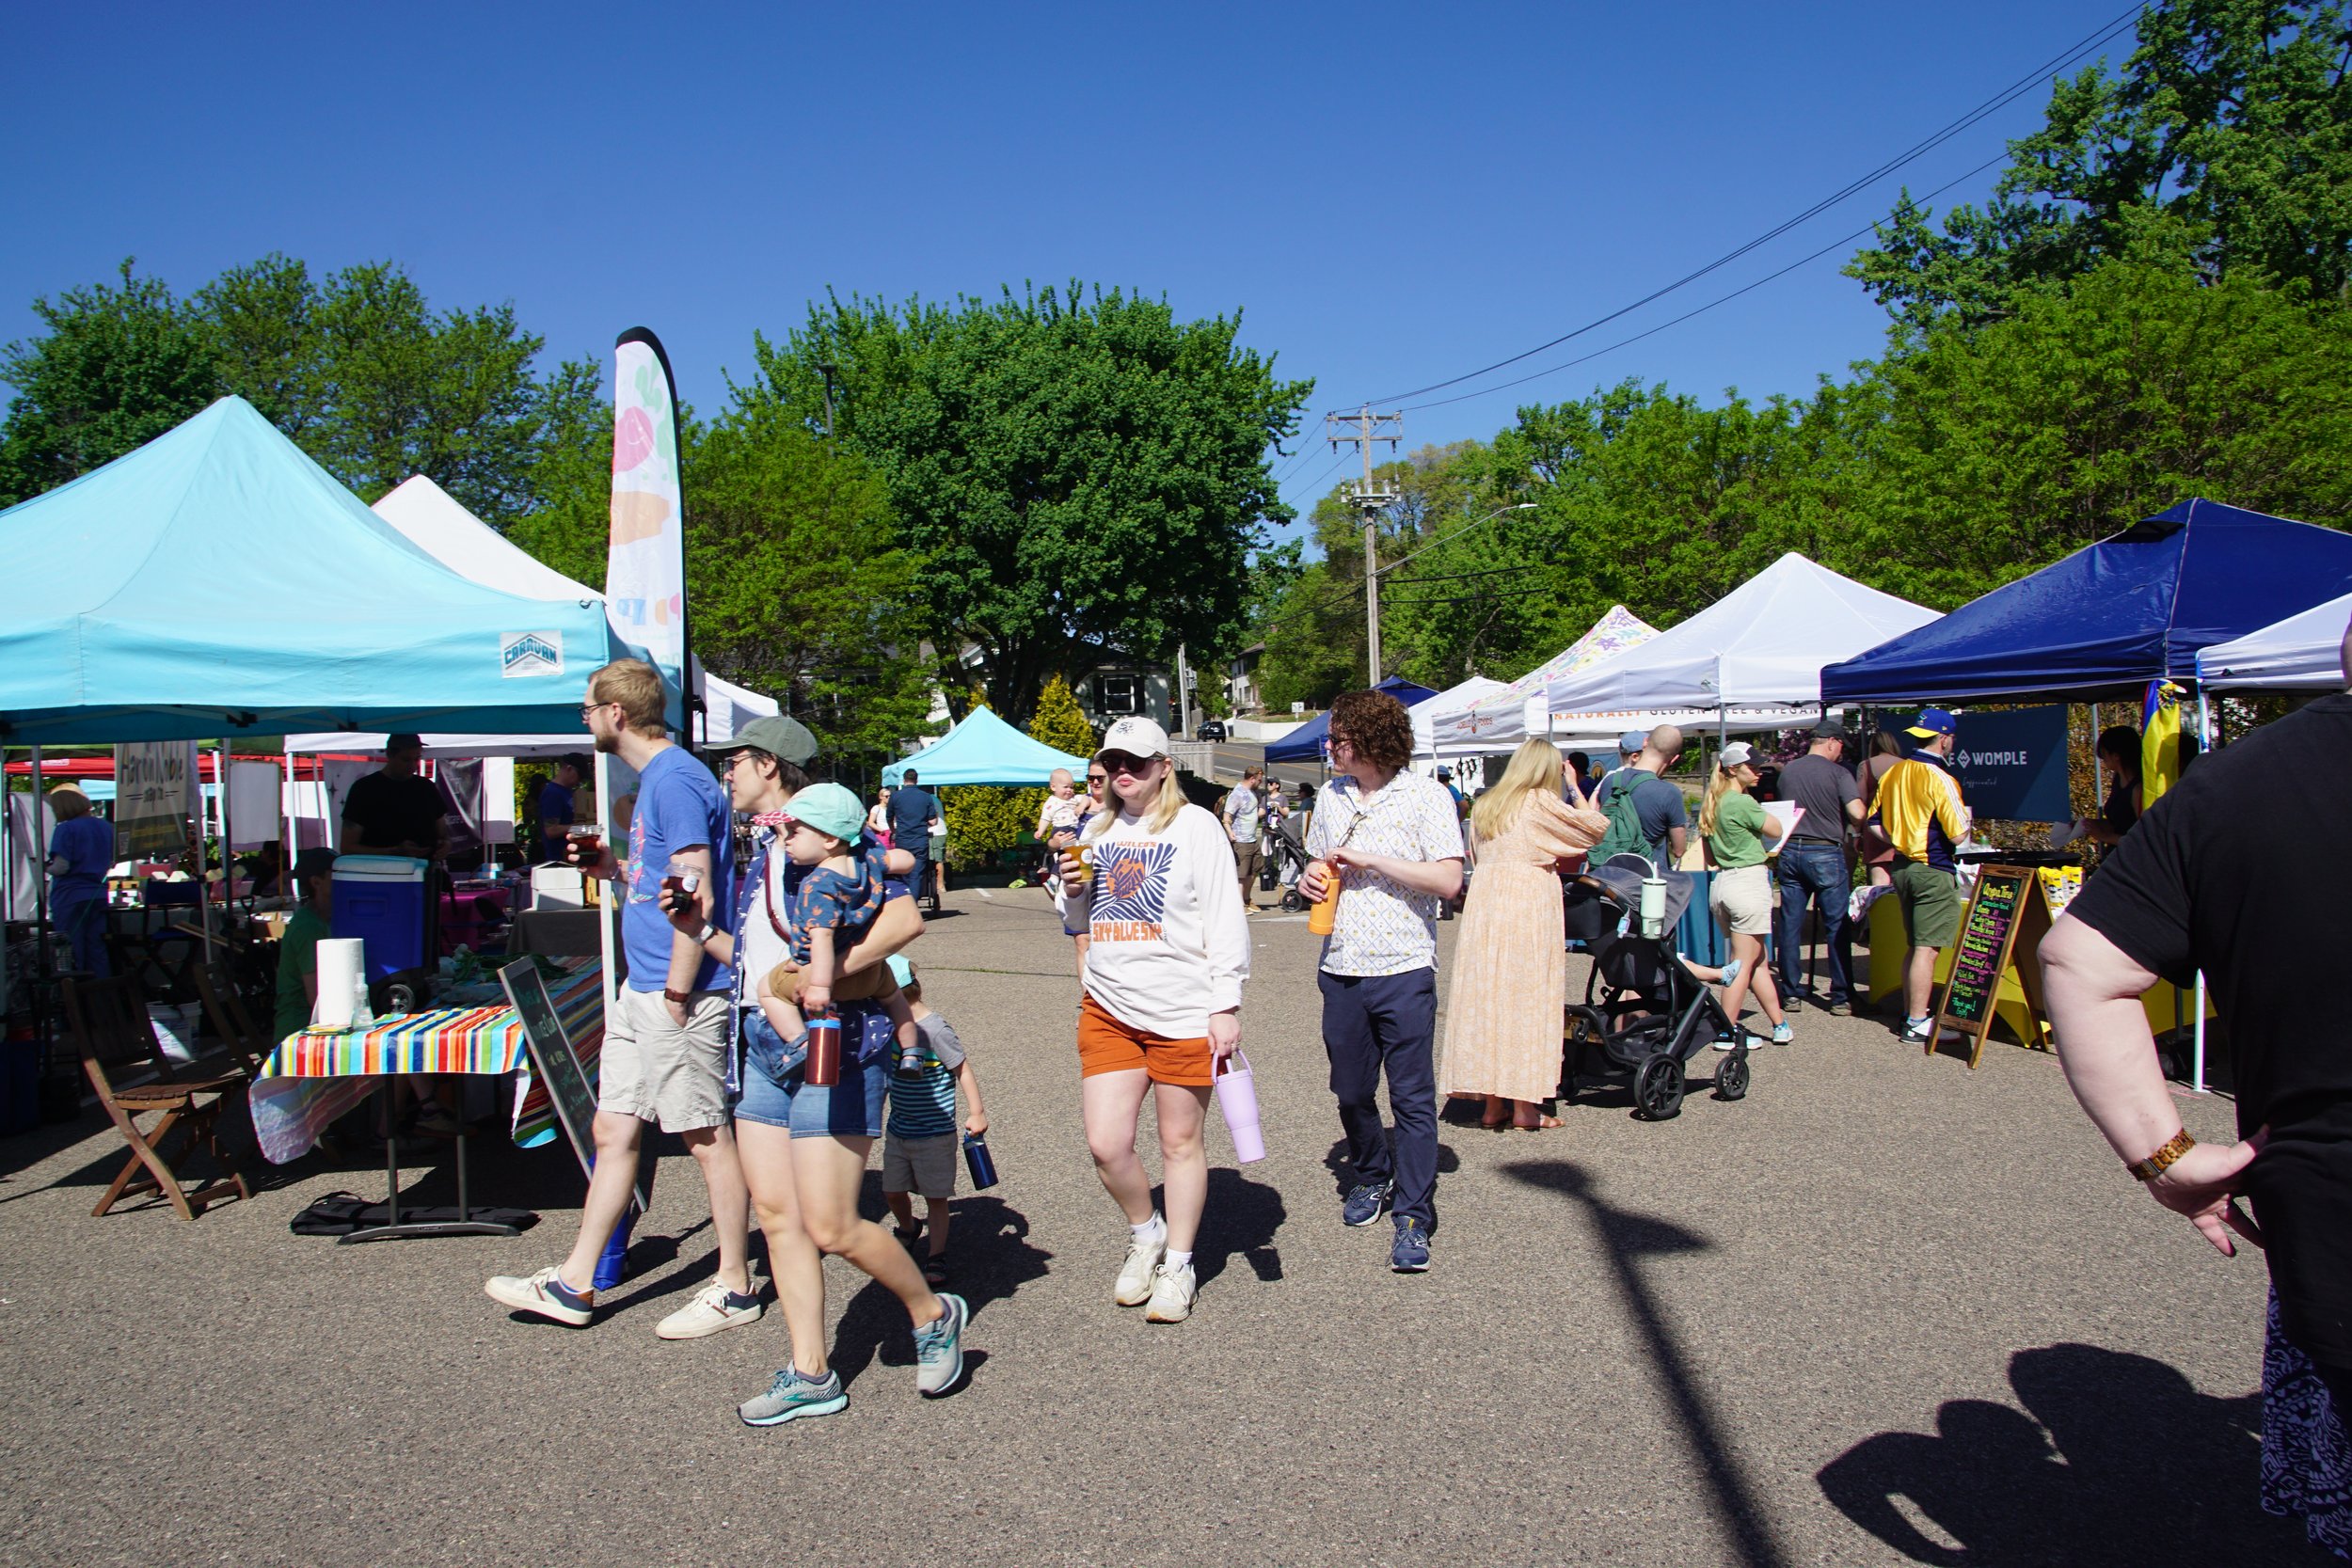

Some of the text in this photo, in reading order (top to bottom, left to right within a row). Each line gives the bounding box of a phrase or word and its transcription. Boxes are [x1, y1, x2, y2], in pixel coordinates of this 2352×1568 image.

[504, 638, 557, 665] CARAVAN
[1972, 751, 2027, 766] WOMPLE
[1093, 922, 1162, 942] SKY BLUE SKY
